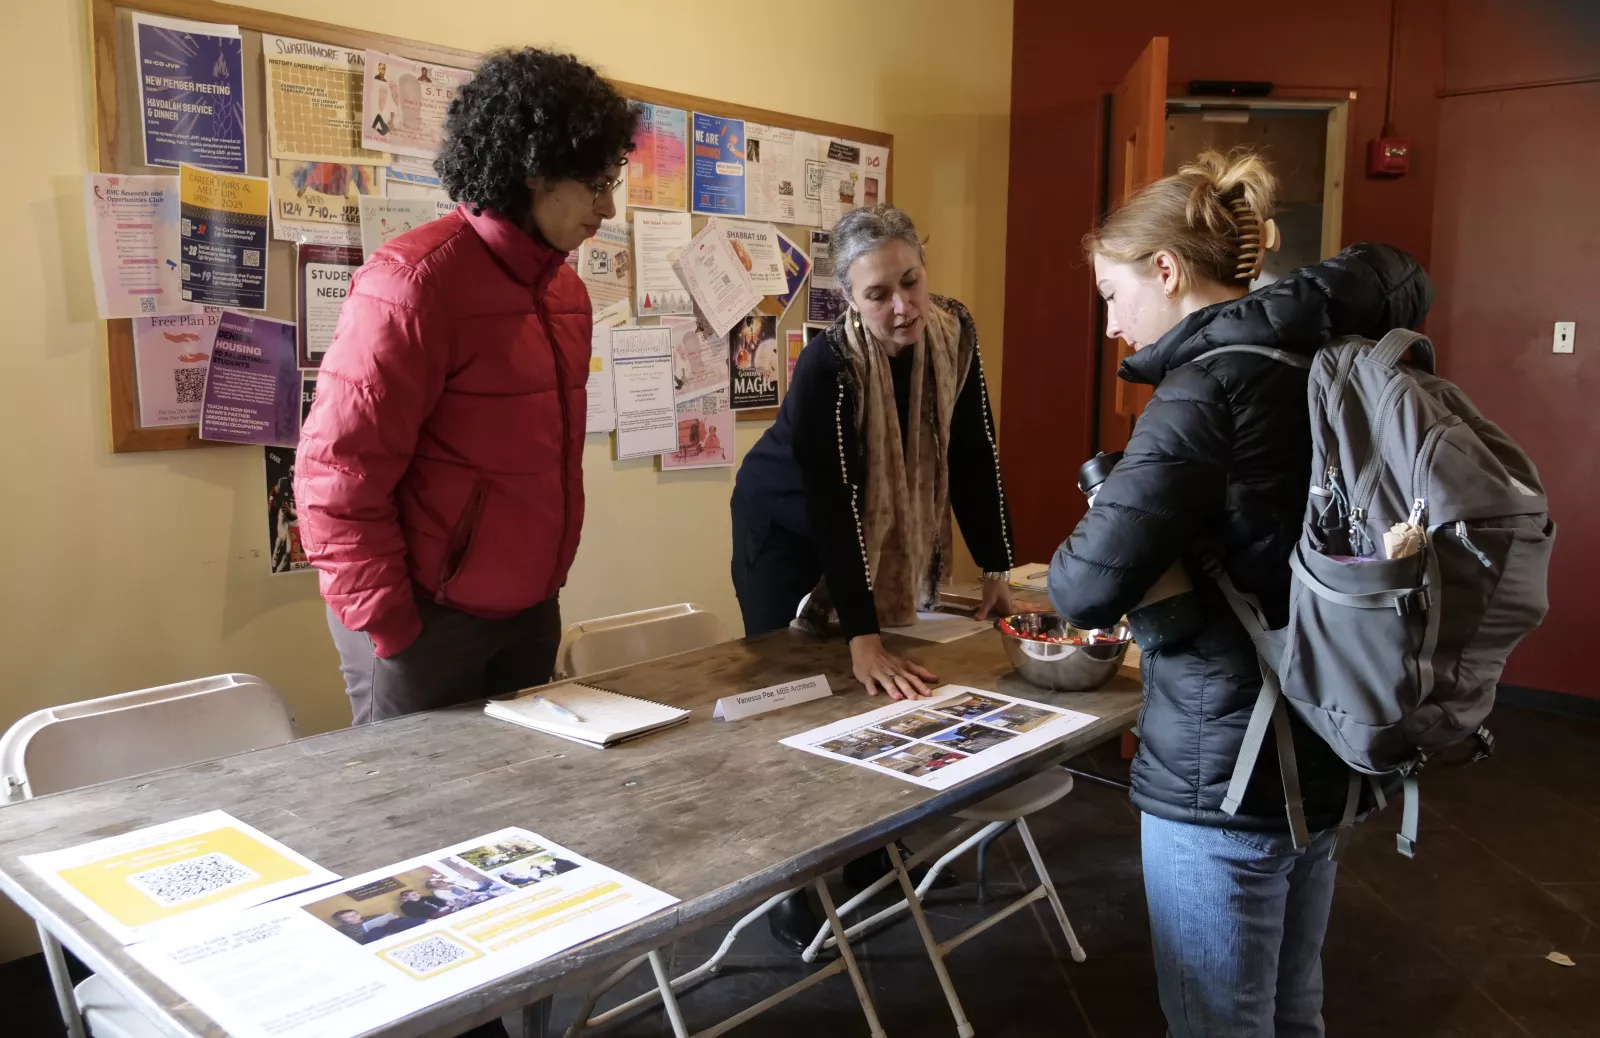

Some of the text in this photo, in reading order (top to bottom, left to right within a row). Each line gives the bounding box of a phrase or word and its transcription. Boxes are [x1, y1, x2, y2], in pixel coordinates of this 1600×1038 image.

[276, 38, 340, 60] SWARTHMORE
[144, 58, 165, 67] BI-CO
[268, 58, 293, 67] HISTORY
[145, 74, 231, 96] NEW MEMBER MEETING
[147, 98, 213, 115] HAVDALAH SERVICE
[147, 108, 179, 121] & DINNER
[695, 129, 720, 146] WE ARE
[189, 172, 215, 186] CAREER
[242, 183, 252, 193] &
[106, 188, 120, 196] BMC
[121, 189, 149, 197] Research
[221, 189, 237, 199] UPS
[106, 196, 147, 204] Opportunities
[193, 193, 244, 209] SPRING 2025
[307, 205, 329, 219] 7-10
[222, 232, 254, 241] Swarthmore)
[726, 230, 755, 241] SHABBAT
[188, 245, 198, 256] 28
[219, 252, 238, 260] Meetup
[201, 270, 212, 281] 19
[316, 287, 349, 299] NEED
[151, 316, 177, 327] Free
[179, 315, 205, 327] Plan
[214, 349, 223, 357] TO
[215, 339, 262, 356] HOUSING
[613, 346, 659, 354] Reasoning
[212, 357, 250, 369] STUDENTS
[734, 376, 775, 395] MAGIC
[230, 422, 263, 431] OCCUPATION
[238, 418, 270, 427] PARTICIPATE
[736, 694, 762, 705] Vanessa
[776, 686, 790, 695] MBB
[790, 681, 817, 692] Architects
